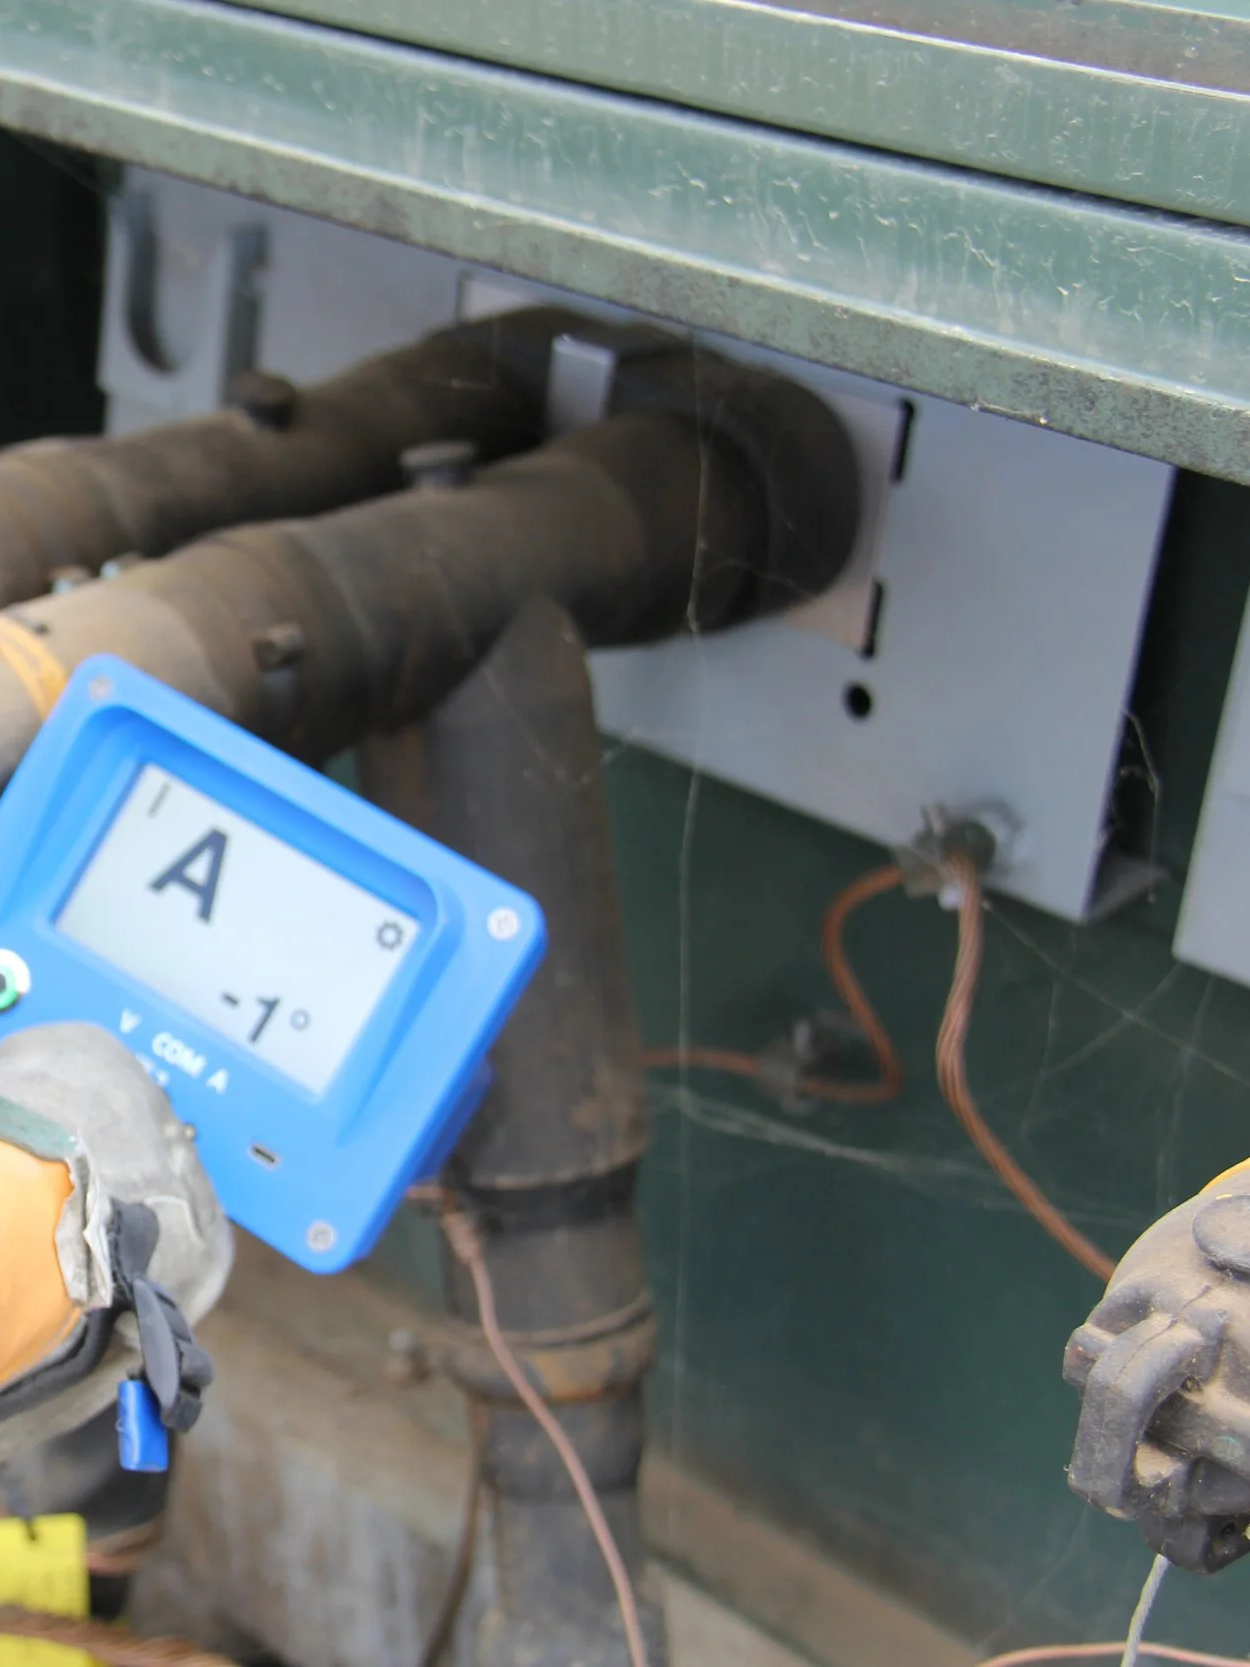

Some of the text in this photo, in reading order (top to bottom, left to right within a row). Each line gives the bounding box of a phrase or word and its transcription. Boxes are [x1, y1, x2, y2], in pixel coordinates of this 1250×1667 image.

[149, 827, 228, 923] A
[120, 1009, 142, 1034] V
[151, 1032, 207, 1078] COM
[206, 1068, 229, 1093] A
